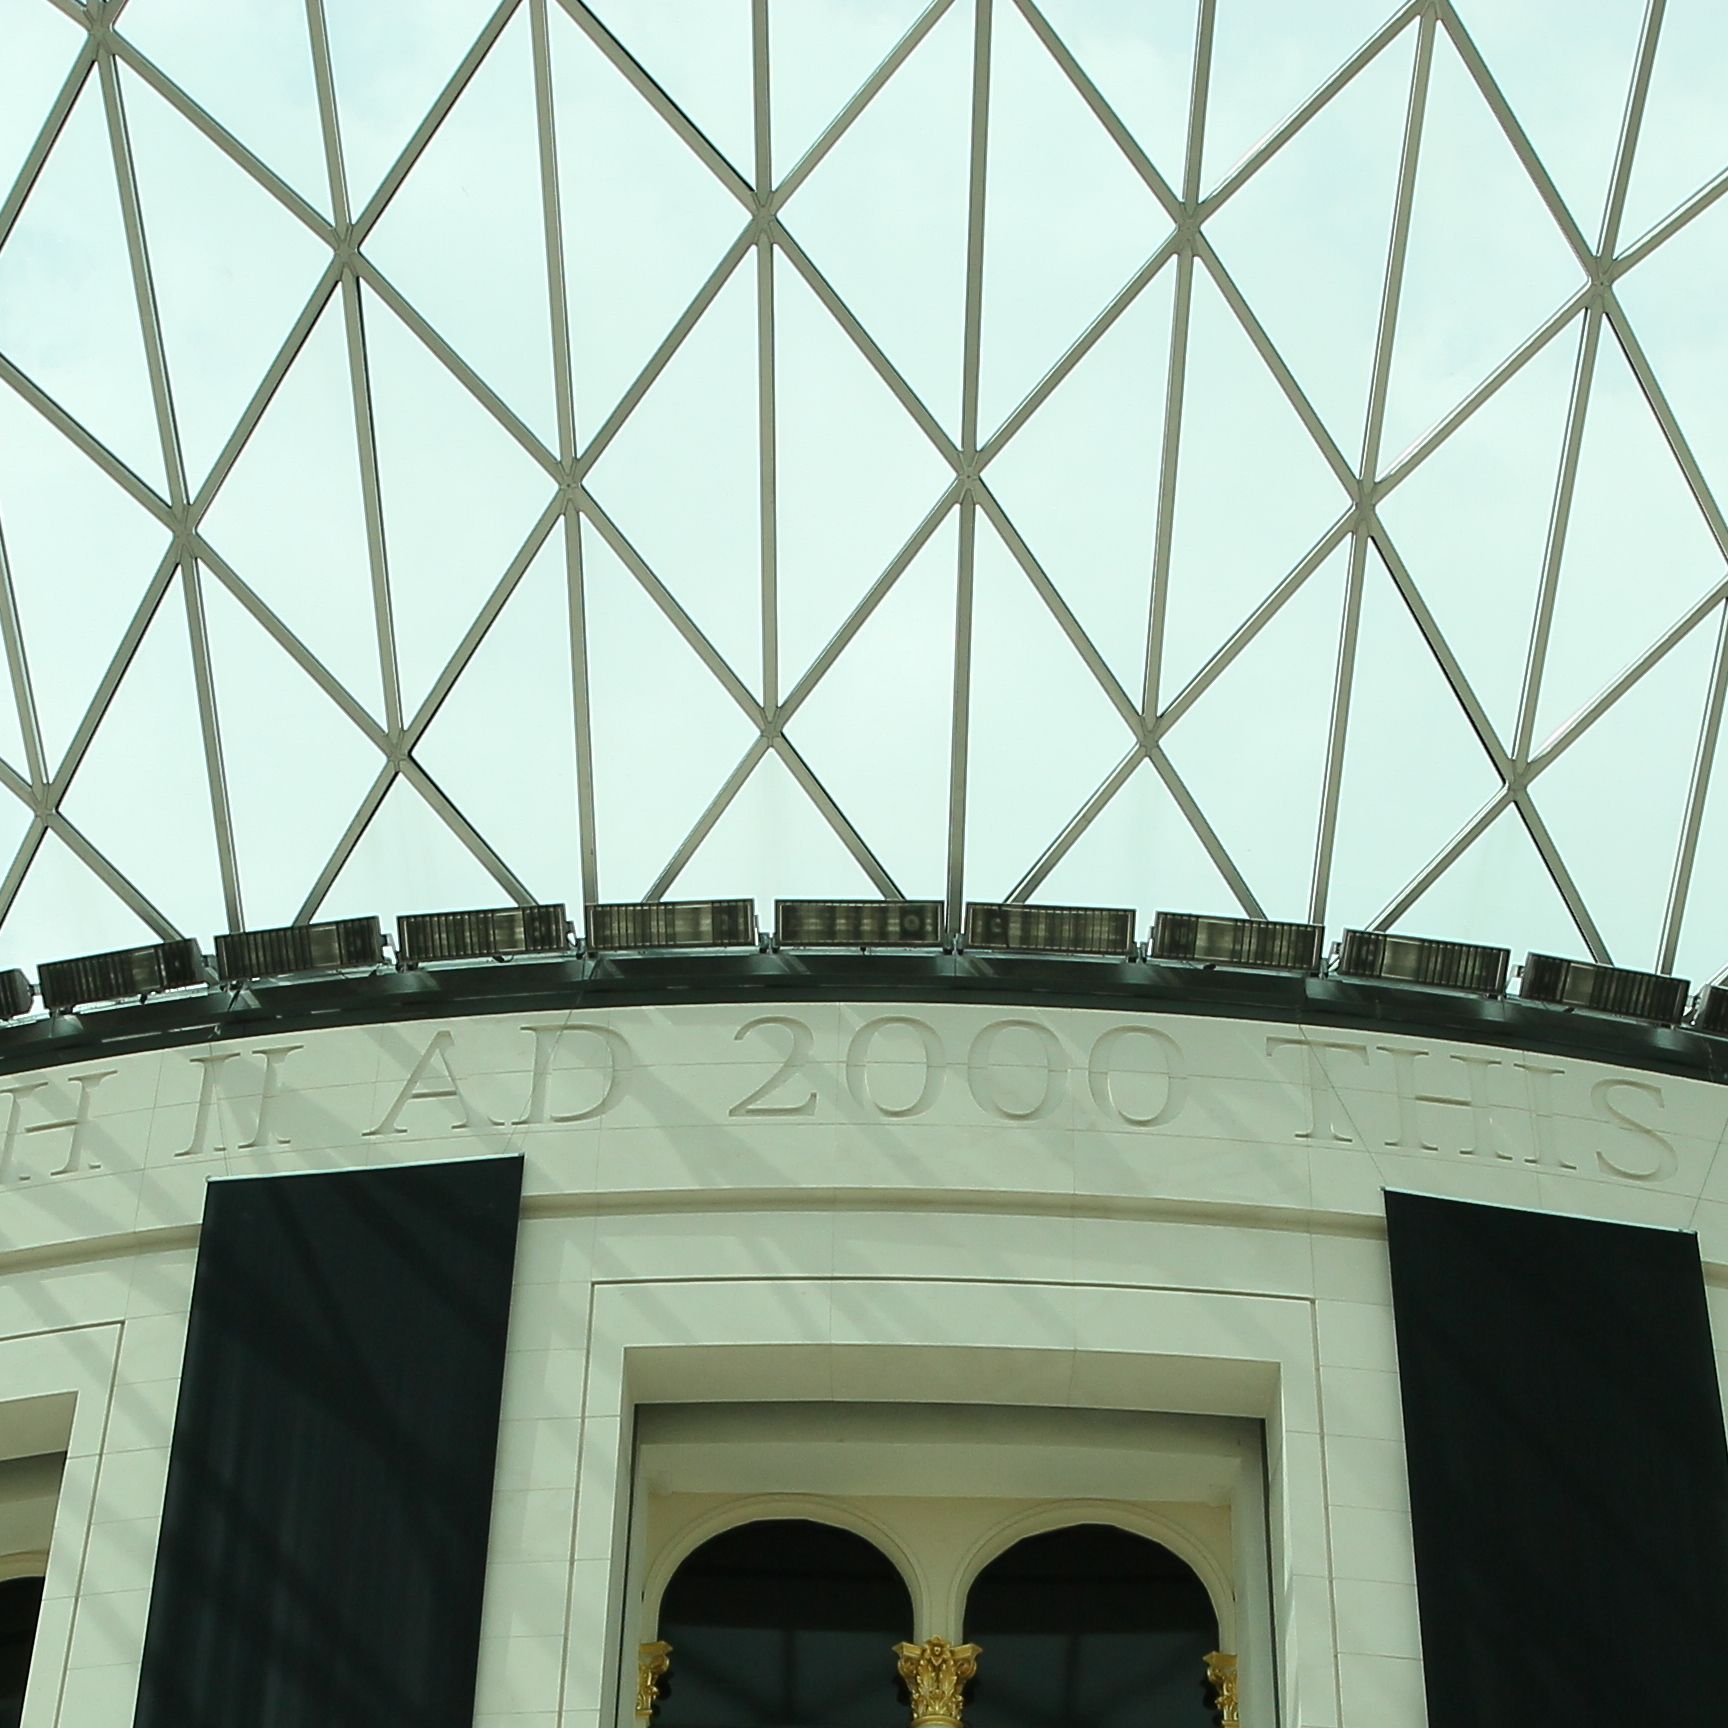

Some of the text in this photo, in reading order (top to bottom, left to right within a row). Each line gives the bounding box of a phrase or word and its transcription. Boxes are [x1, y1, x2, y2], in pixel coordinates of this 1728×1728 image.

[174, 1044, 305, 1159] II
[361, 1022, 635, 1137] AD
[727, 1014, 1188, 1128] 2000
[1265, 1035, 1679, 1183] THIS
